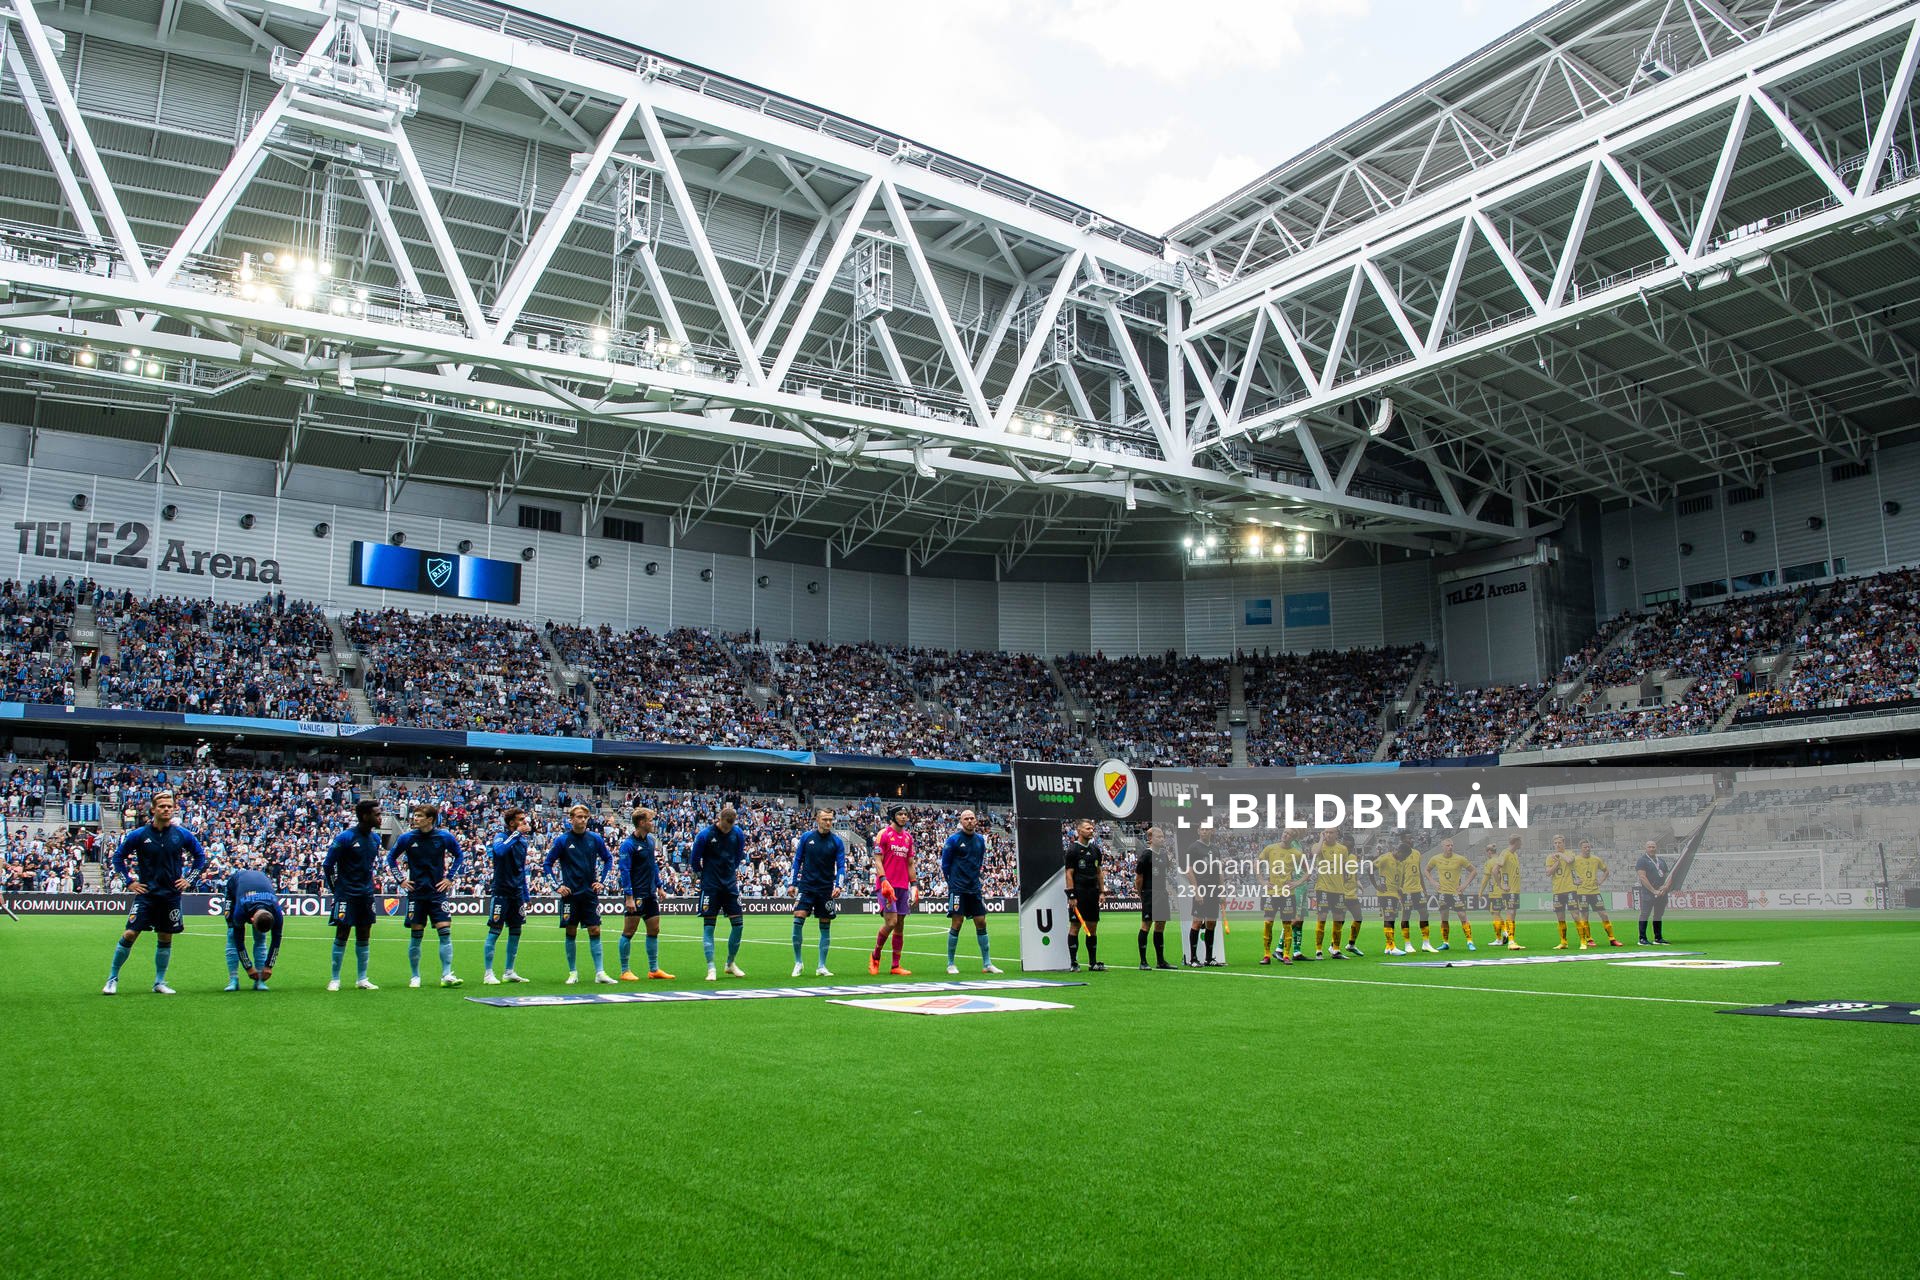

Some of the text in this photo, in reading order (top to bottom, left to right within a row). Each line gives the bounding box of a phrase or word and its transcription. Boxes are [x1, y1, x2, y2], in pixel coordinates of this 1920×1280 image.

[14, 521, 282, 585] TELE2 Arena
[1446, 581, 1527, 606] TELE2 Arena
[1025, 775, 1083, 793] UNIBET
[1148, 781, 1199, 799] UNIBET
[13, 899, 126, 911] KOMMUNIKATION
[658, 903, 694, 912] FFEKTIV
[749, 903, 767, 912] OCH
[1695, 889, 1743, 909] Finans
[1778, 892, 1853, 906] SEFAB
